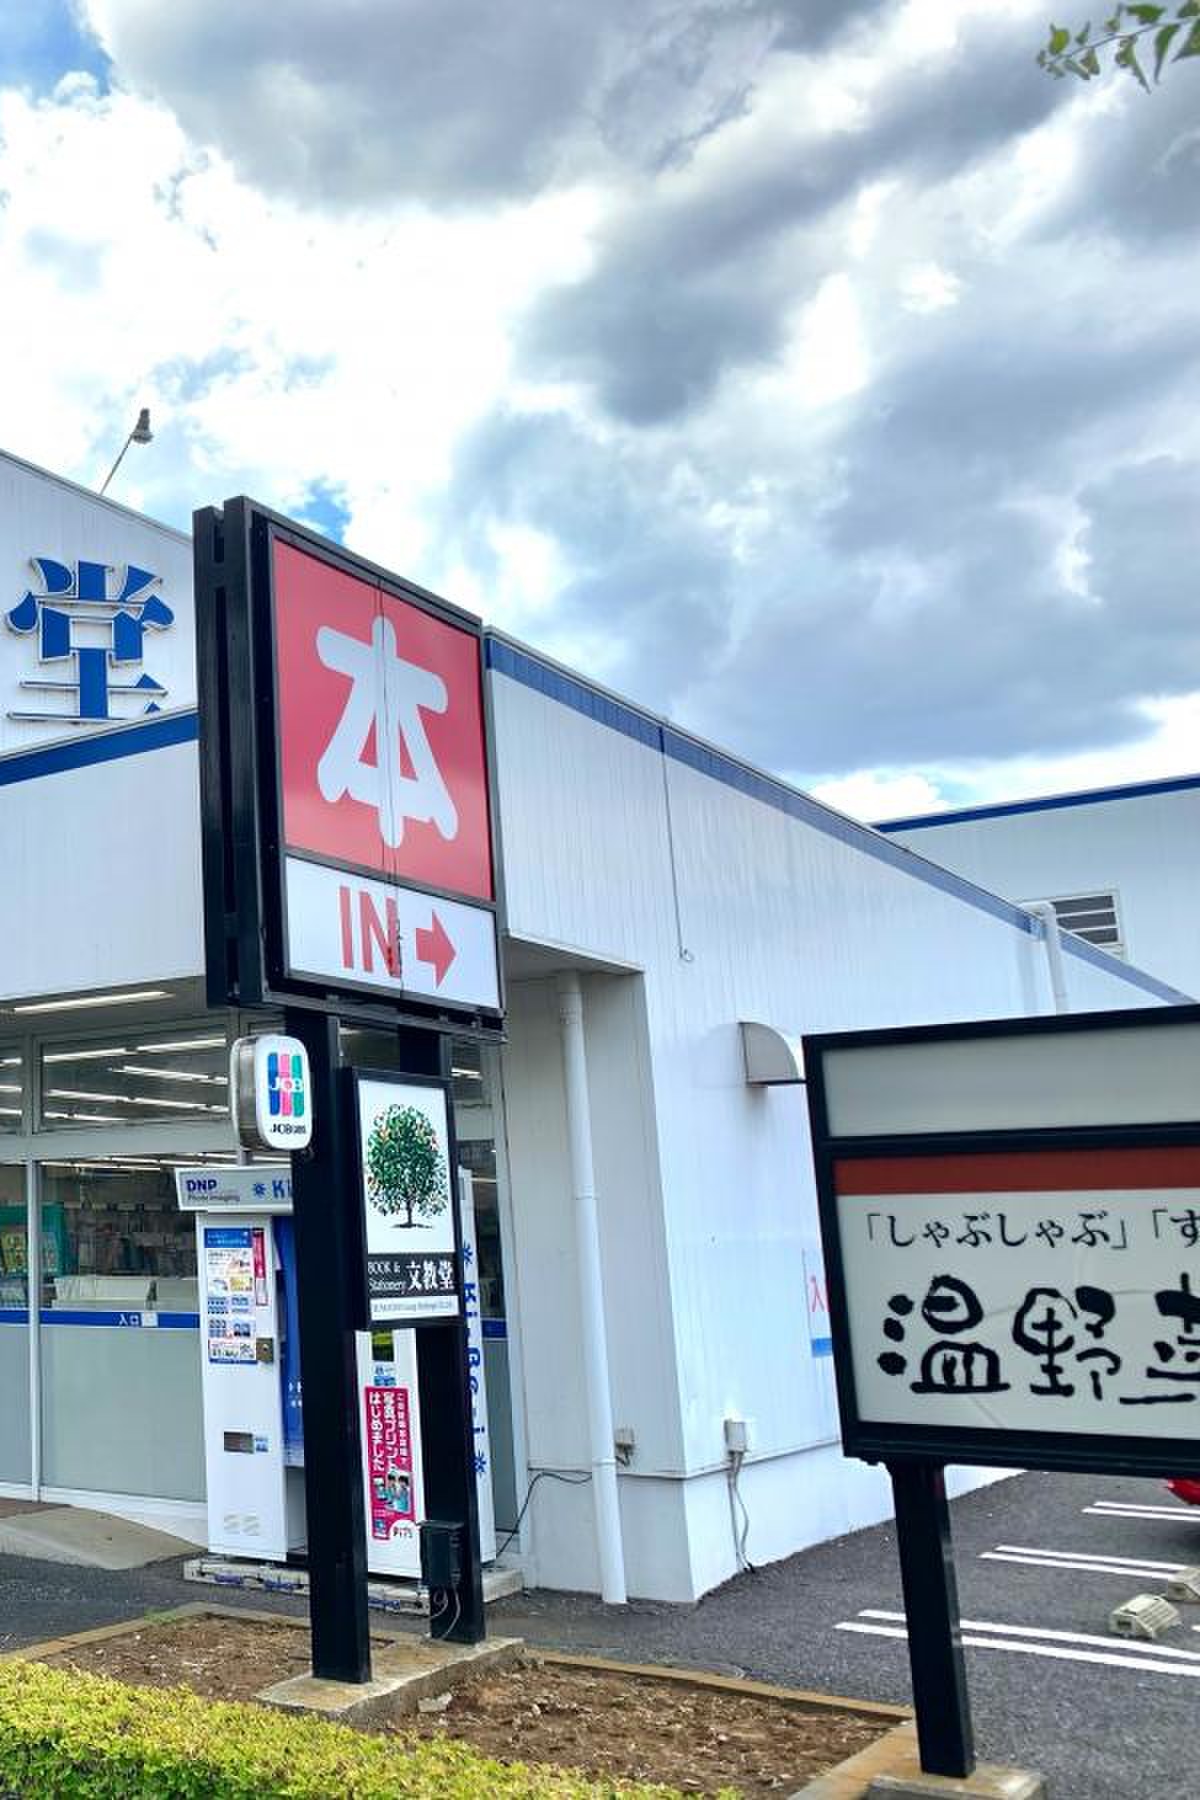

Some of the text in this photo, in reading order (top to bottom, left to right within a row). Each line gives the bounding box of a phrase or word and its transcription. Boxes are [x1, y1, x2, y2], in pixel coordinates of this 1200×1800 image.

[315, 615, 459, 849] 本
[339, 885, 401, 979] IN
[186, 1179, 217, 1192] DNP
[405, 1260, 455, 1291] 文教堂
[118, 1313, 140, 1327] 入口
[369, 1391, 385, 1471] はじめました
